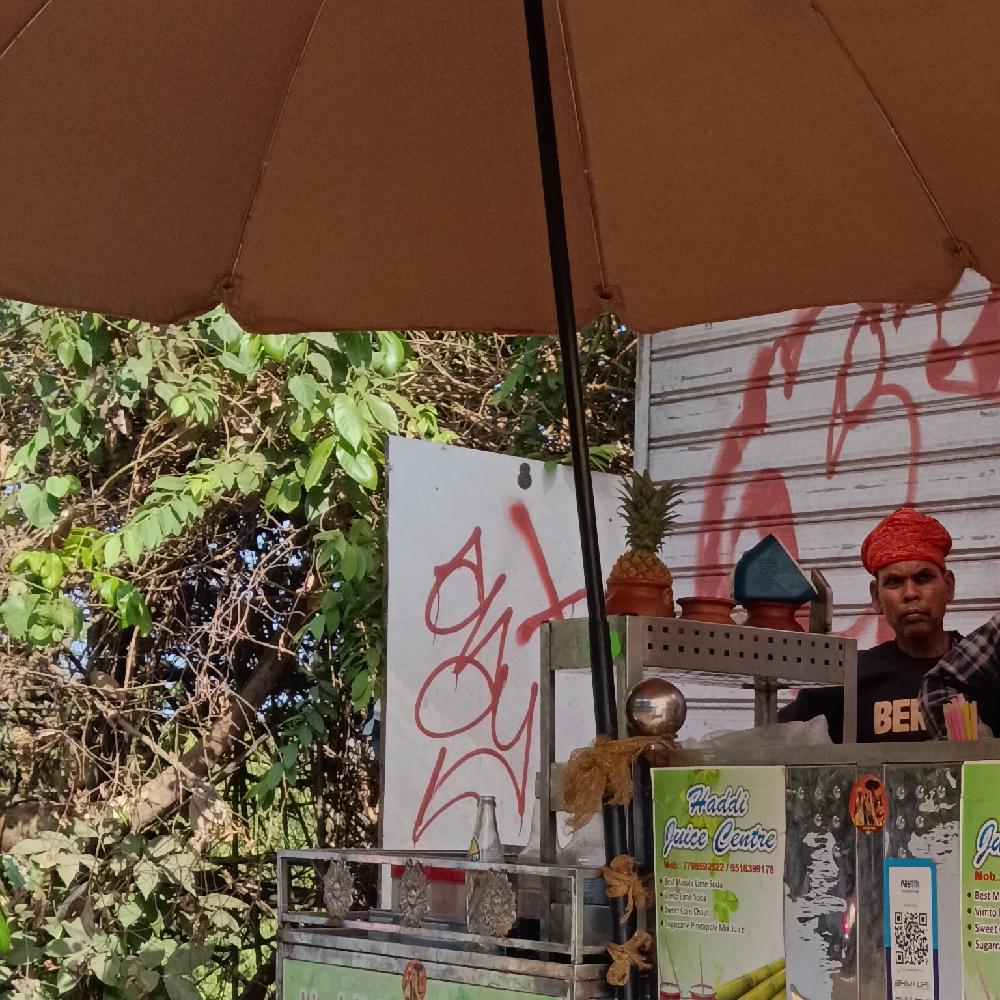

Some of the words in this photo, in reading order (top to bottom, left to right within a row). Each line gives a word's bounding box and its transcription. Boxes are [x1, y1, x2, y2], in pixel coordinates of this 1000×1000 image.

[687, 784, 749, 815] Haddi
[663, 819, 708, 857] Juice
[714, 819, 777, 854] Centre
[974, 890, 991, 901] Best
[974, 923, 998, 934] Sweet
